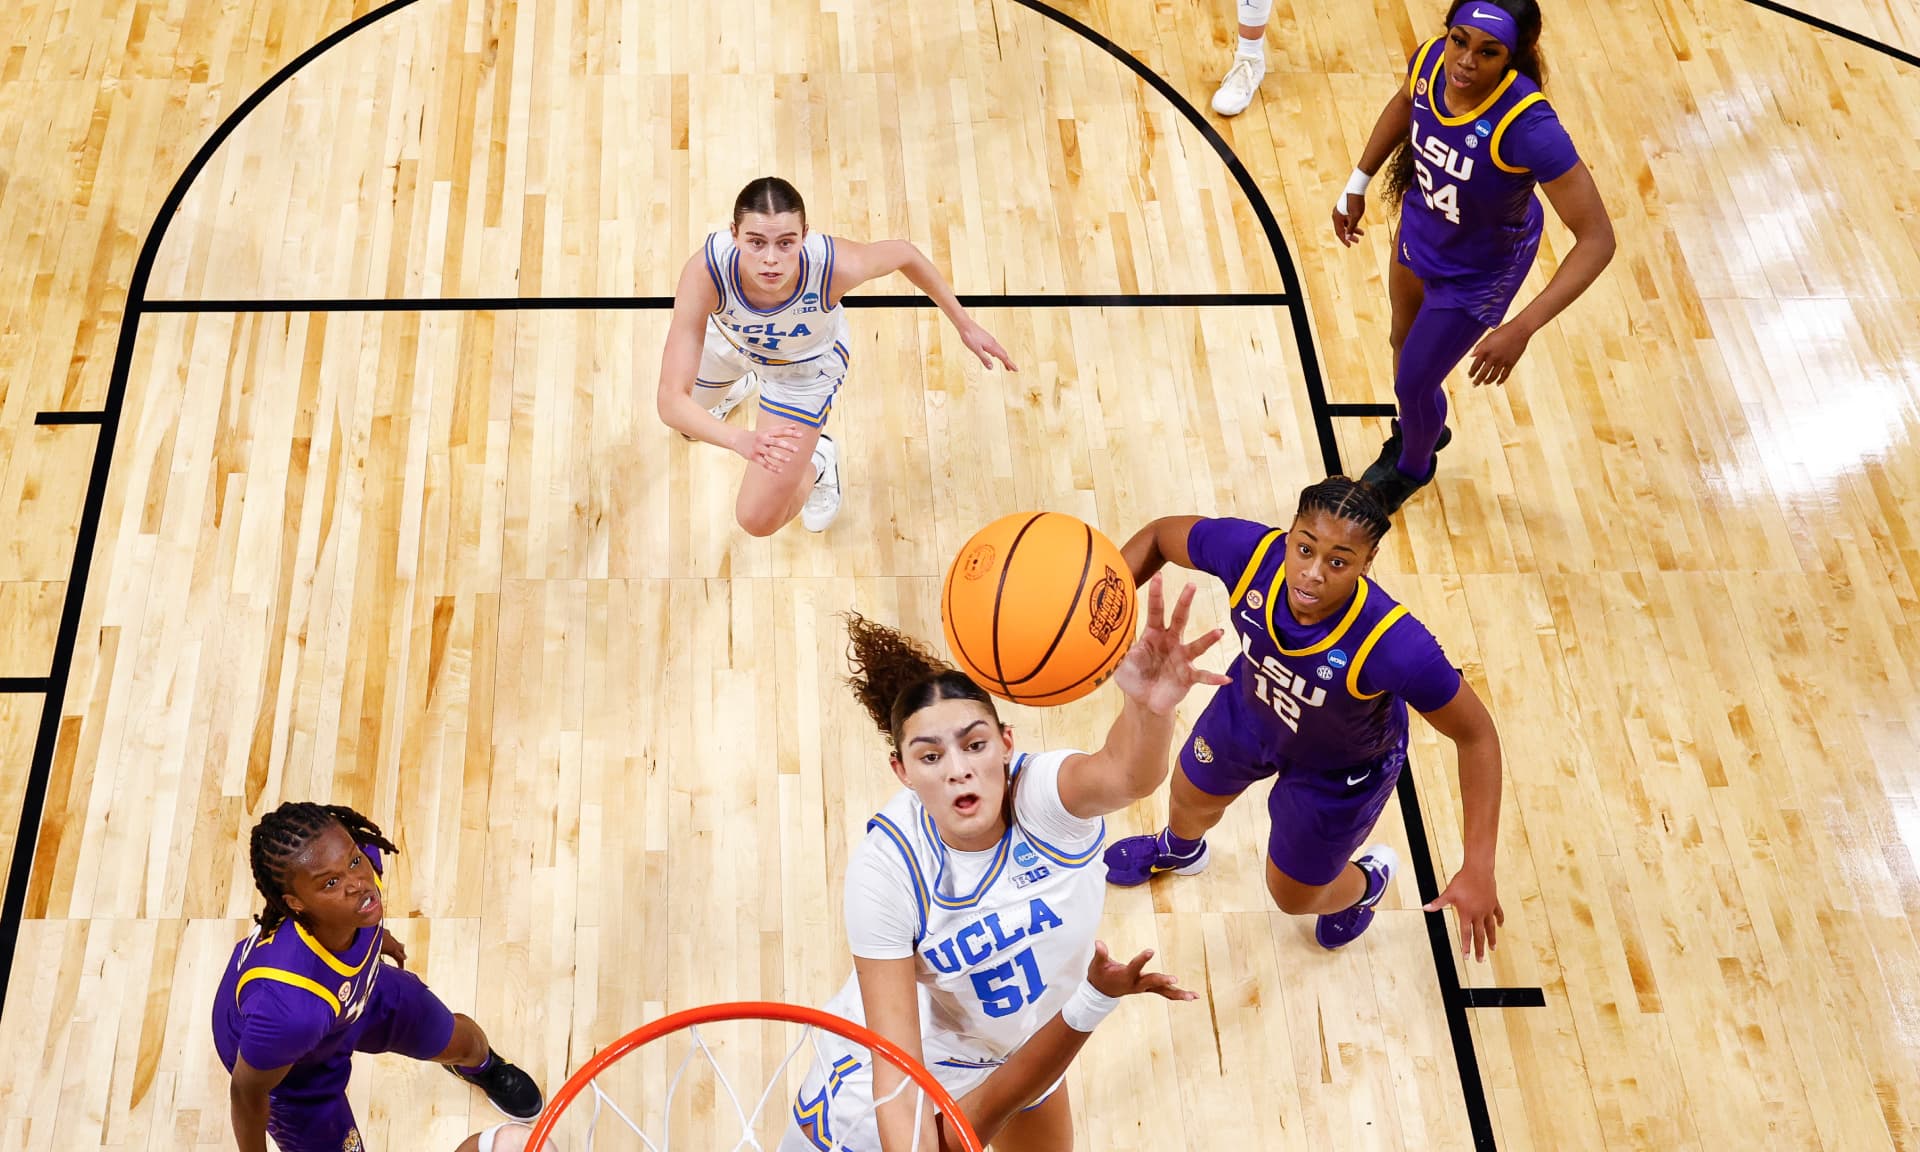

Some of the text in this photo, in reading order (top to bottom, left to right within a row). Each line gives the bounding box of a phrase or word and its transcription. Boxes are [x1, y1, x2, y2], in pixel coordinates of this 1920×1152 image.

[1411, 119, 1474, 182] LSU
[1415, 159, 1460, 225] 24
[1242, 632, 1327, 707] LSU
[1254, 673, 1301, 735] 12
[924, 898, 1063, 974] UCLA
[970, 947, 1048, 1018] 51
